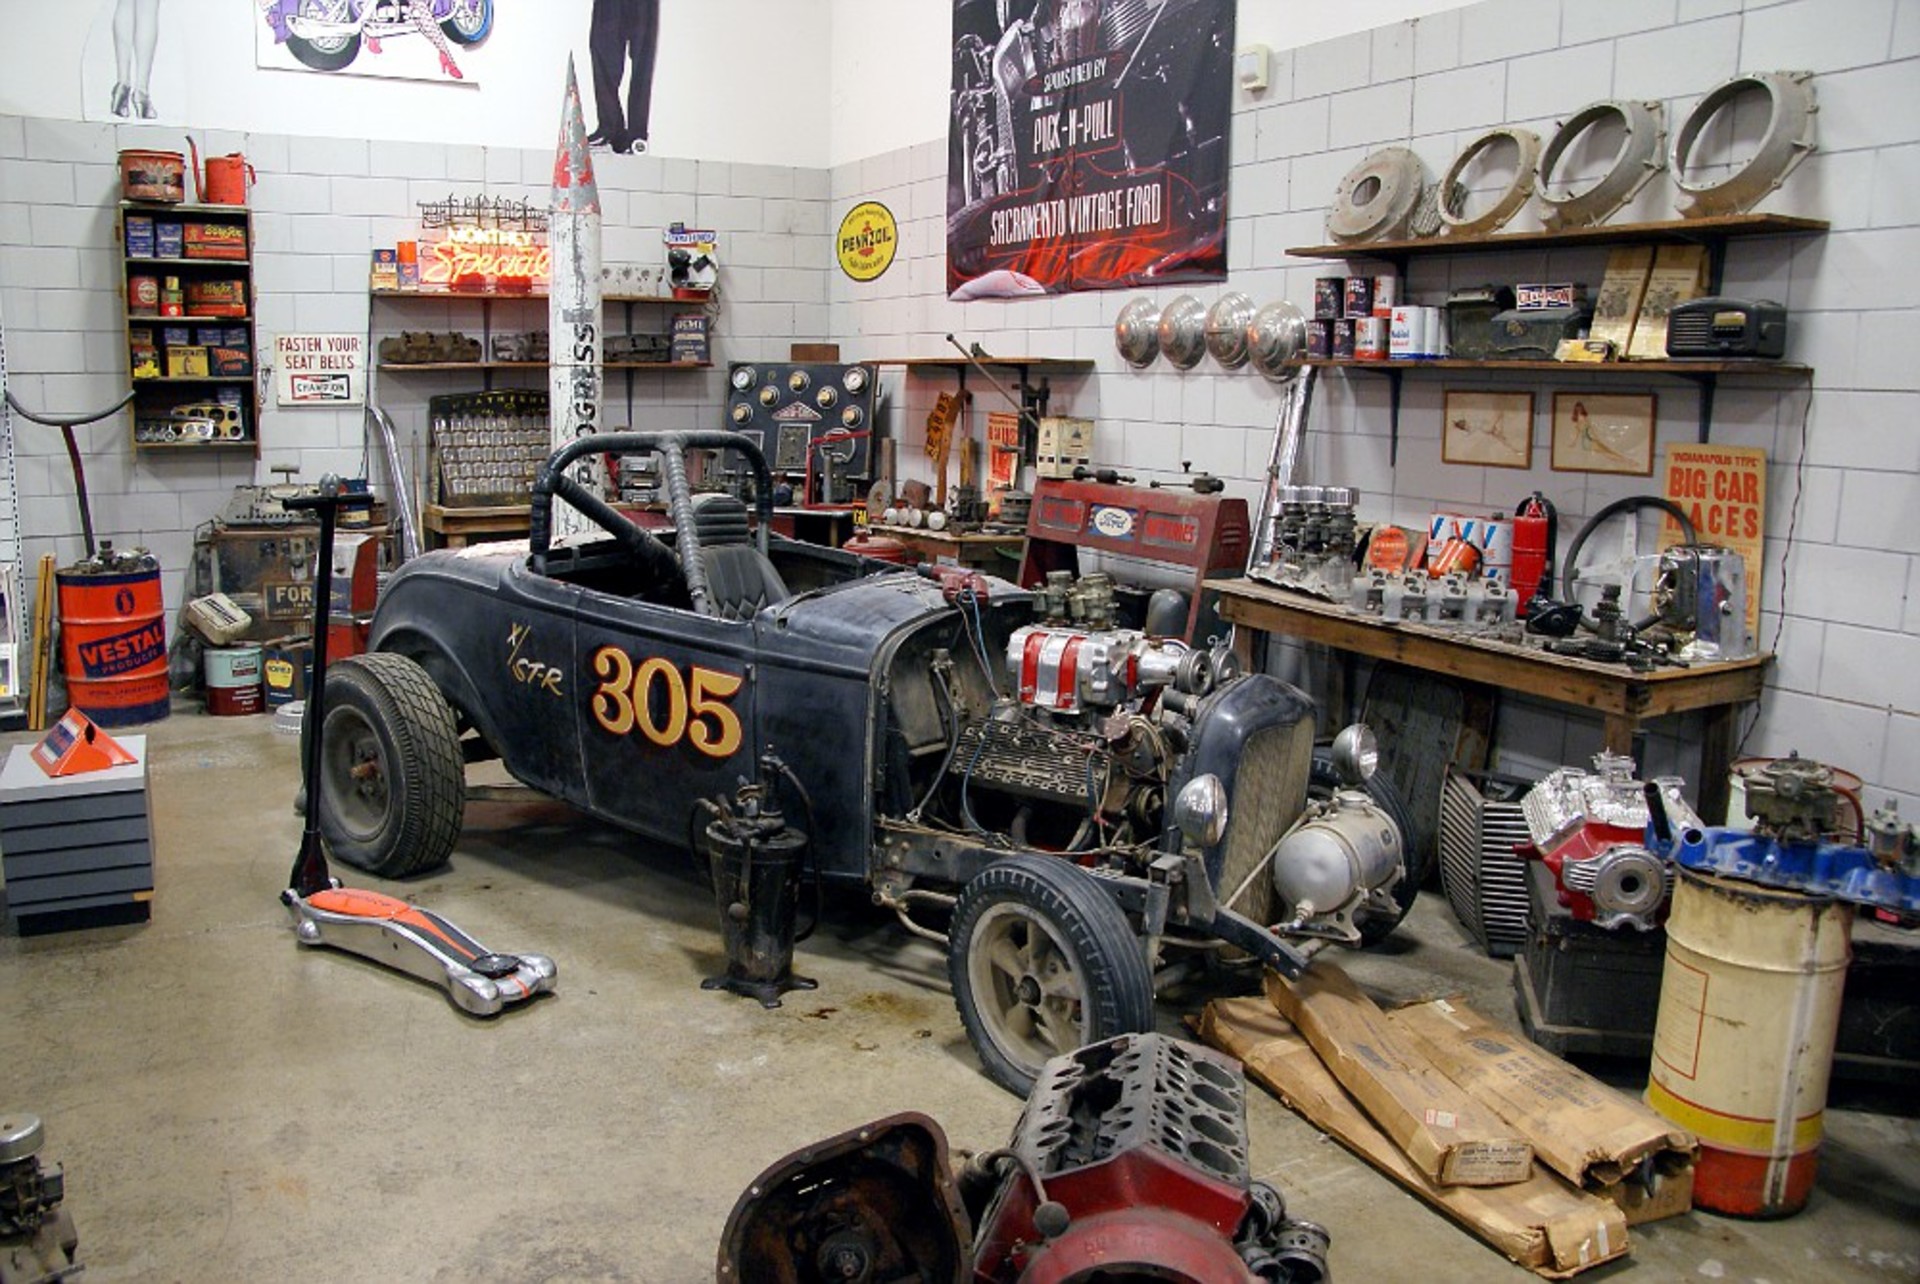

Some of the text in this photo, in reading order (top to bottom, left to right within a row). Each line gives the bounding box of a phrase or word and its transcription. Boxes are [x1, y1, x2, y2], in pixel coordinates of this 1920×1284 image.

[1094, 57, 1107, 77] BY
[1033, 99, 1114, 154] PICK-N-PULL
[990, 183, 1161, 246] SACRAMENTO VINTAGE FORD
[448, 227, 535, 247] MONTHLY
[842, 226, 892, 254] PENNZOIL
[279, 336, 360, 352] FASTEN YOUR
[285, 355, 354, 369] SEAT BELTS
[296, 382, 345, 393] CHAMPION
[1669, 466, 1759, 504] BIG CAR
[1099, 511, 1128, 530] Ford
[276, 585, 312, 604] FOR
[82, 625, 163, 667] VESTAL
[101, 650, 160, 676] PRODUCTS
[592, 645, 743, 758] 305
